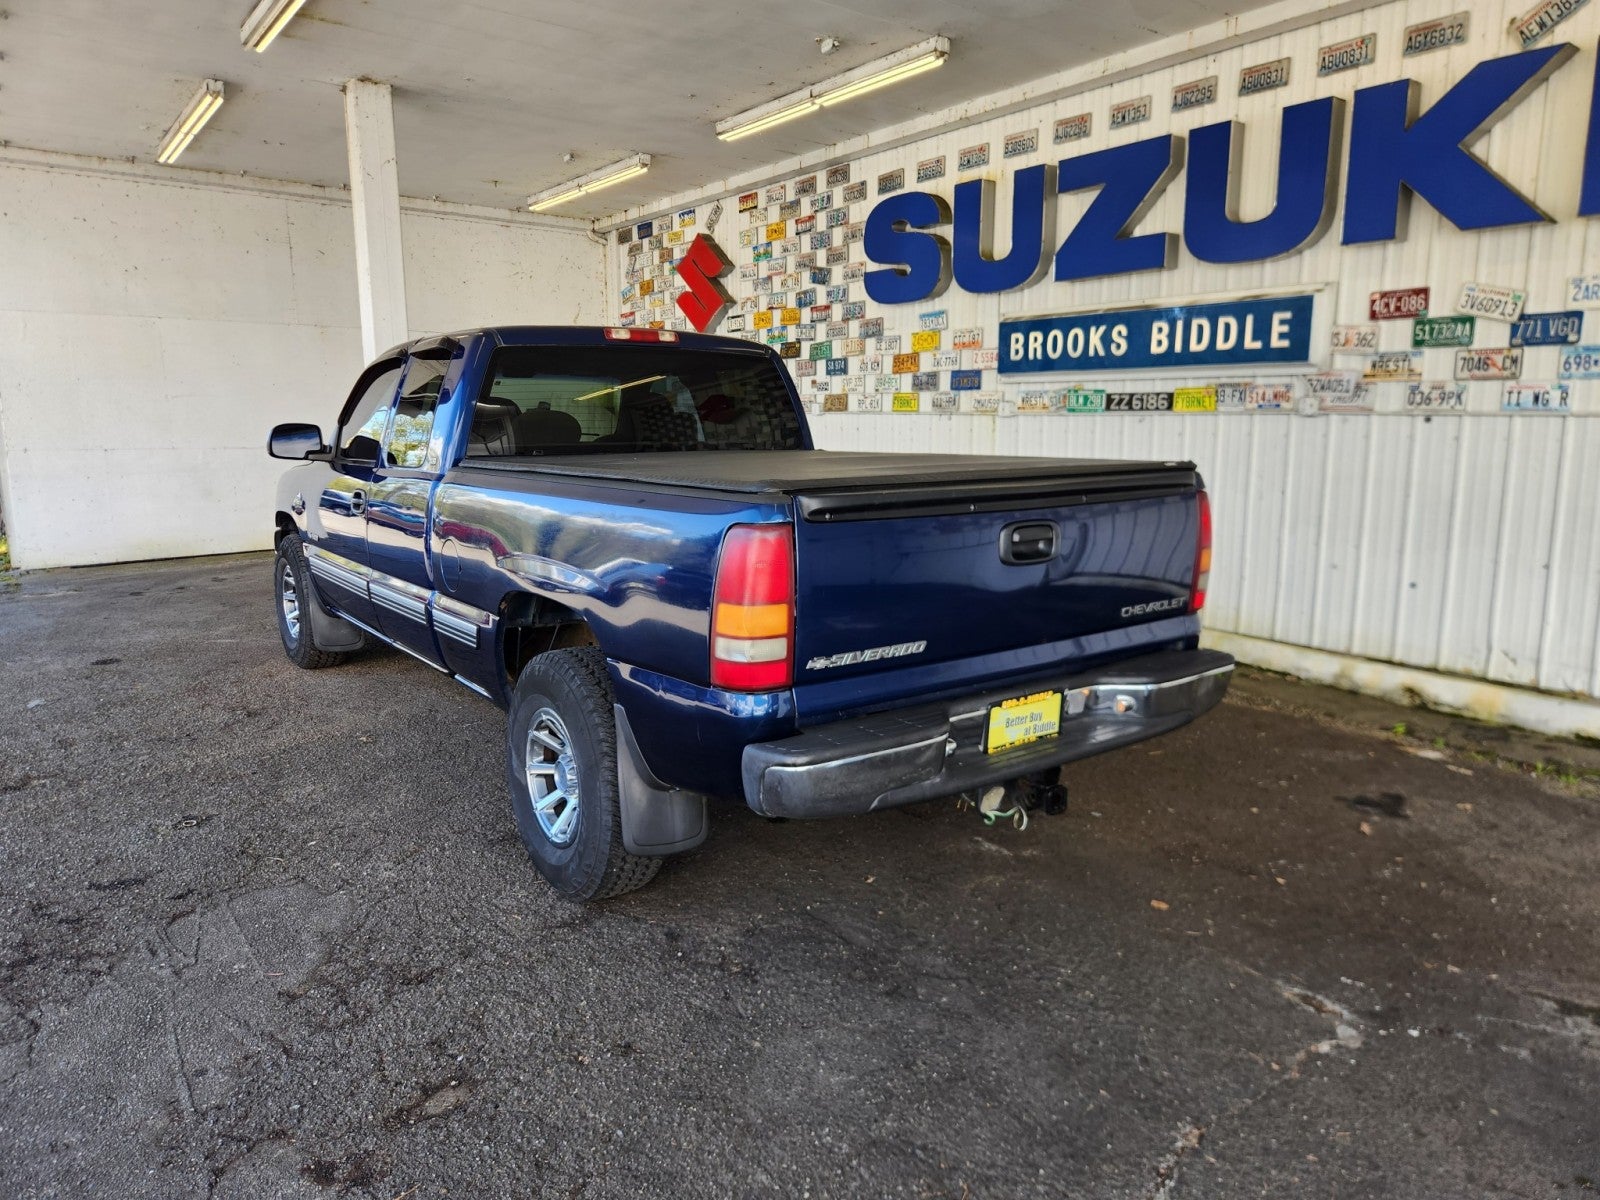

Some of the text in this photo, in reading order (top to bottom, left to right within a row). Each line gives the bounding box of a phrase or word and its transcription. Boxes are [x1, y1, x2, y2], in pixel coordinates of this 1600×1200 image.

[1405, 23, 1463, 52] AGY6832
[1320, 45, 1369, 72] ABU0831
[1372, 293, 1425, 314] 4CV-086
[1461, 293, 1518, 317] 3V60913
[1009, 311, 1292, 361] BROOKS BIDDLE
[1110, 393, 1169, 410] ZZ 6186
[1121, 596, 1187, 617] CHEVROLET
[830, 640, 927, 667] SILVERADO
[1005, 711, 1042, 728] Better Buy
